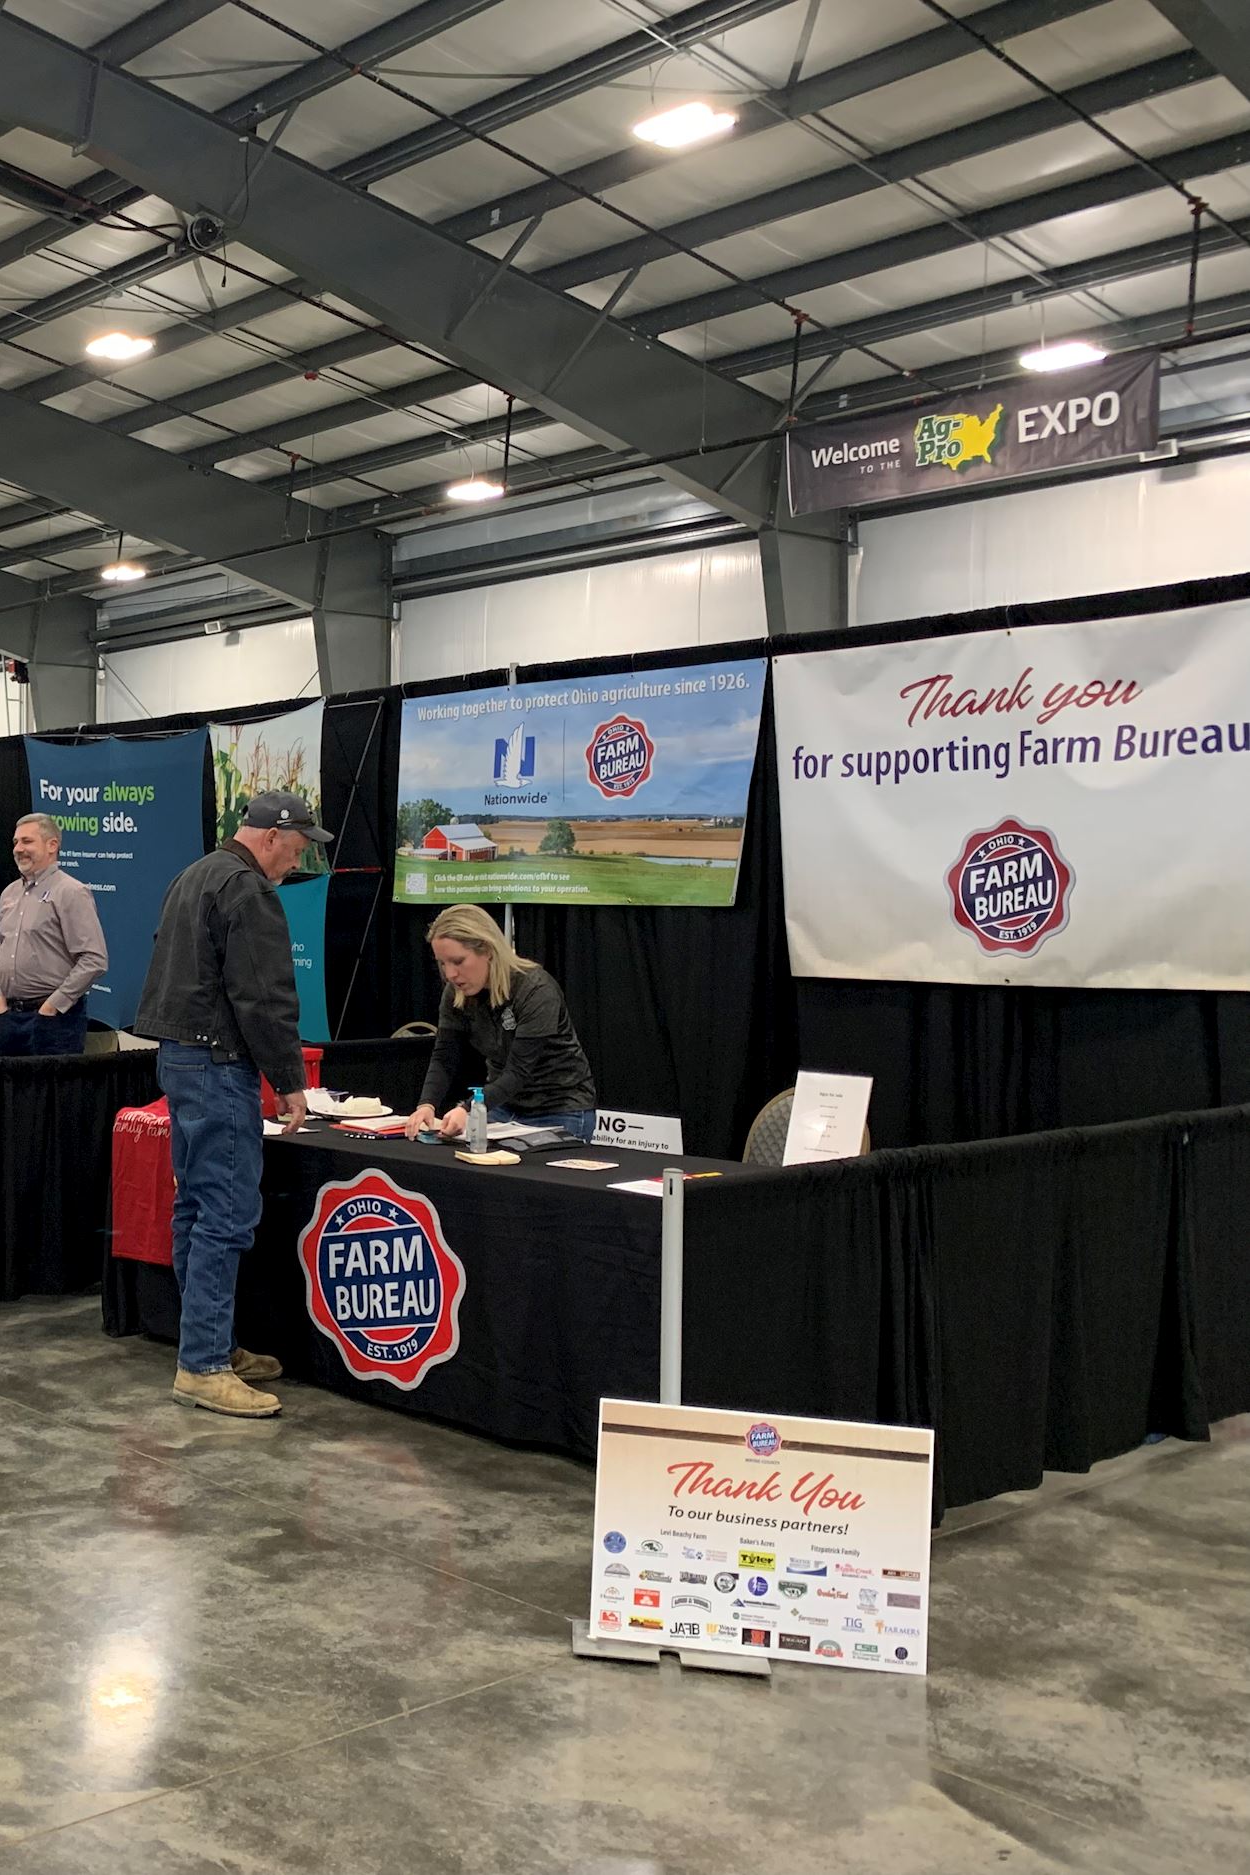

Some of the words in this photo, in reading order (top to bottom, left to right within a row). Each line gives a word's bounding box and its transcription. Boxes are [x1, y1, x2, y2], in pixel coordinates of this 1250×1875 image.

[1018, 390, 1120, 443] EXPO
[917, 416, 962, 442] Ag-
[811, 437, 900, 468] Welcome
[917, 440, 962, 466] Pro
[860, 465, 874, 474] TO
[881, 459, 900, 471] THE
[418, 704, 460, 721] Working
[462, 697, 507, 718] together
[510, 696, 523, 710] to
[525, 692, 569, 713] protect
[571, 688, 598, 705] Ohio
[601, 681, 670, 706] agriculture
[674, 678, 706, 695] since
[709, 672, 750, 692] 1926.
[900, 667, 1034, 728] Thank
[1036, 679, 1144, 725] you
[607, 725, 624, 736] OHIO
[597, 734, 639, 763] FARM
[792, 745, 834, 780] for
[840, 735, 1011, 786] supporting
[1019, 730, 1101, 767] Farm
[1113, 722, 1250, 762] Bureau
[600, 751, 645, 780] BUREAU
[40, 779, 63, 801] For
[66, 786, 100, 806] your
[102, 781, 155, 806] always
[484, 791, 548, 806] Nationwide
[52, 812, 99, 836] owing
[102, 811, 138, 833] side.
[988, 835, 1015, 850] OHIO
[550, 873, 558, 881] to
[559, 873, 570, 881] see
[969, 852, 1043, 895] FARM
[503, 884, 531, 893] solutions
[540, 886, 557, 894] your
[556, 884, 591, 894] operation.
[974, 880, 1053, 921] BUREAU
[999, 929, 1017, 940] EST.
[1017, 921, 1038, 938] 1919
[616, 1136, 626, 1145] for
[638, 1140, 660, 1150] injury
[347, 1201, 382, 1216] OHIO
[328, 1234, 424, 1279] FARM
[335, 1278, 435, 1321] BUREAU
[366, 1342, 393, 1359] EST.
[393, 1338, 419, 1359] 1919
[751, 1431, 775, 1441] FARM
[667, 1461, 782, 1502] Thank
[790, 1471, 866, 1516] You
[668, 1505, 684, 1519] To
[687, 1509, 713, 1521] our
[715, 1510, 778, 1528] business
[780, 1520, 849, 1536] partners!
[660, 1528, 672, 1537] Levi
[672, 1529, 692, 1540] Beachy
[693, 1531, 707, 1540] Farm
[739, 1537, 760, 1546] Baker's
[741, 1552, 774, 1564] Tyler
[811, 1544, 840, 1555] Fitzpatrick
[841, 1547, 861, 1558] Family
[844, 1616, 863, 1629] TIG
[884, 1625, 920, 1636] FARMERS
